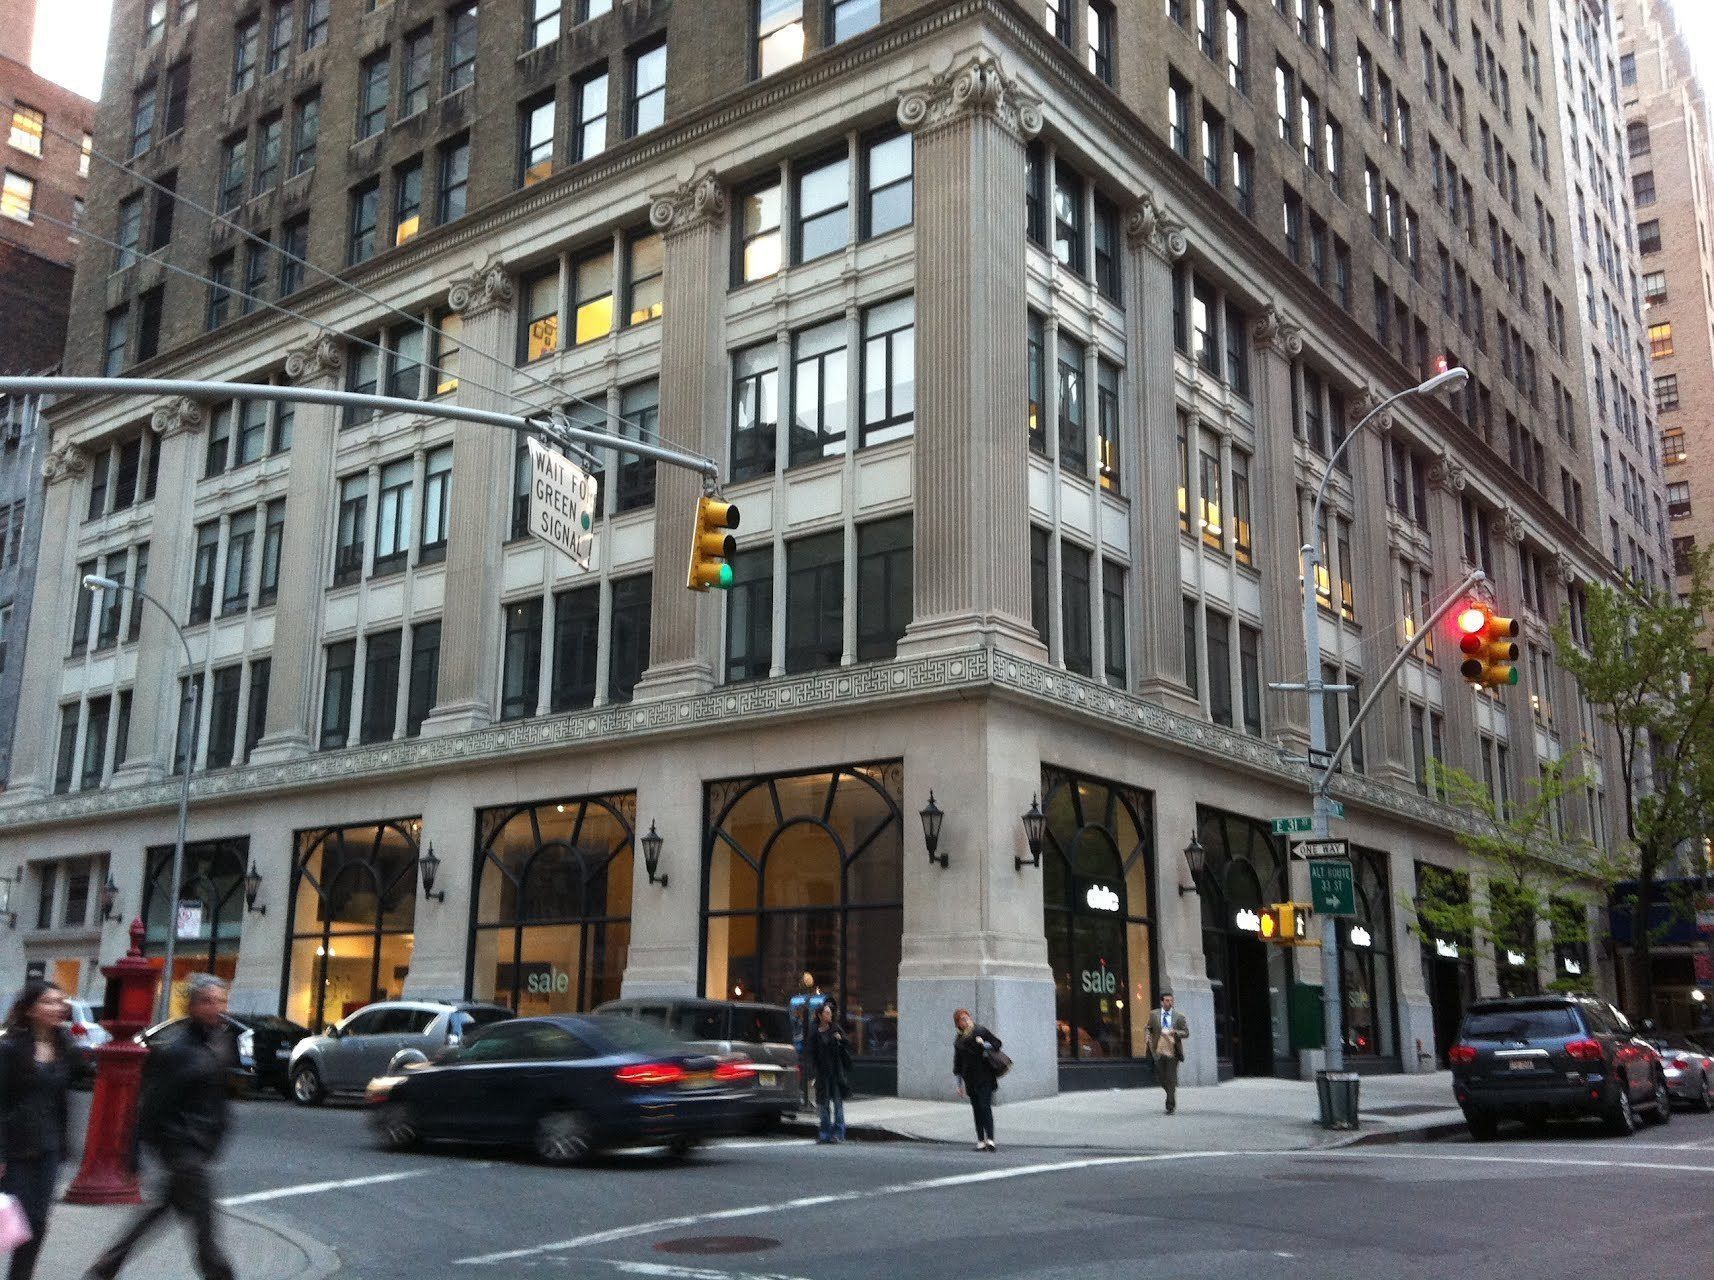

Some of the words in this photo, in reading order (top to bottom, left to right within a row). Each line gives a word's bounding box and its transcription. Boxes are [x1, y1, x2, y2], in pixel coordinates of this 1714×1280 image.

[536, 451, 564, 485] WAIT
[536, 479, 577, 522] GREEN
[541, 511, 582, 557] SIGNAL
[1288, 818, 1298, 831] 31
[1300, 846, 1319, 855] ONE
[1322, 845, 1340, 854] WAY
[527, 966, 569, 993] sale
[1082, 966, 1116, 994] sale
